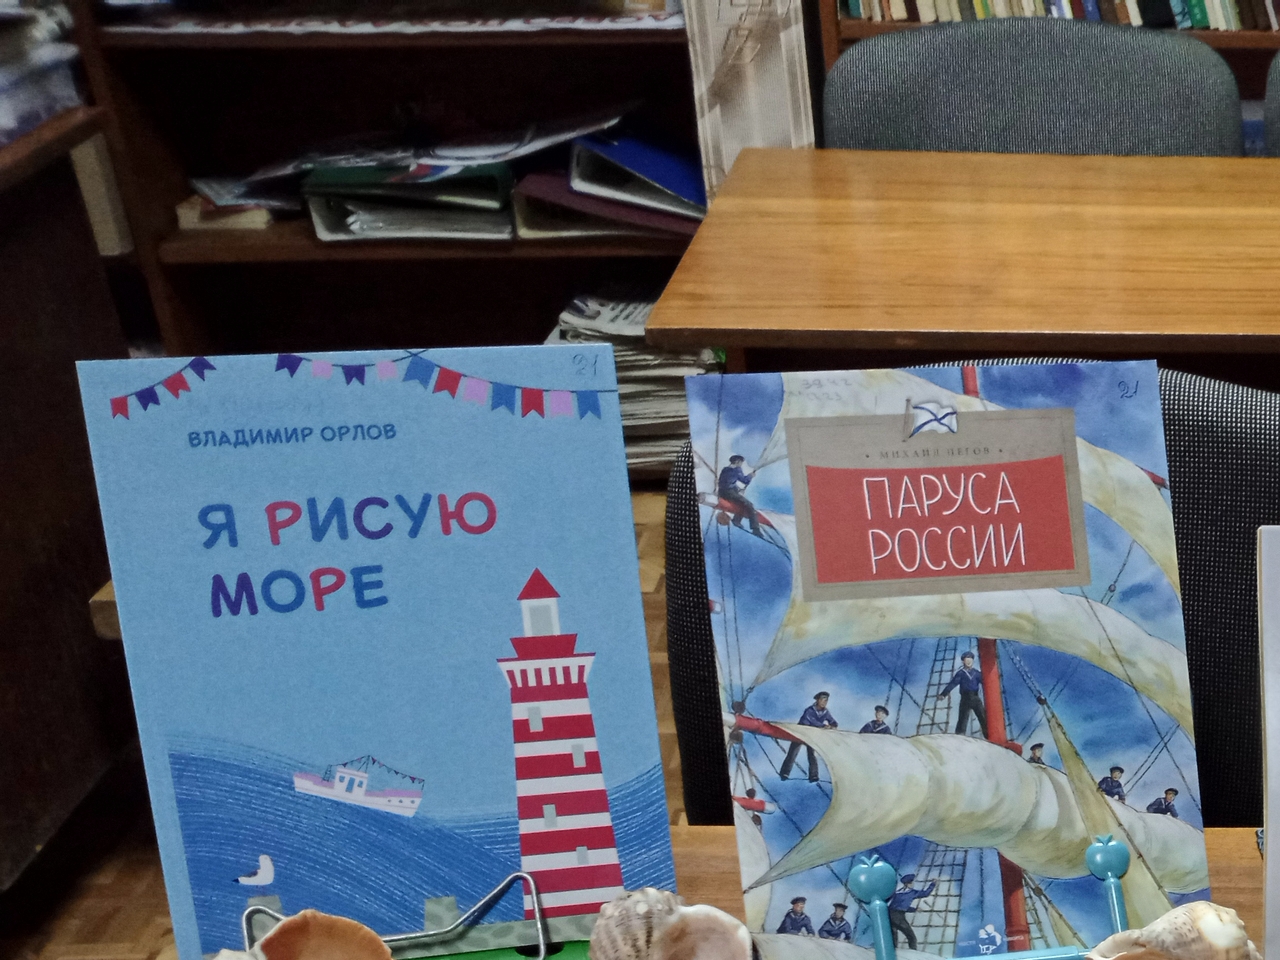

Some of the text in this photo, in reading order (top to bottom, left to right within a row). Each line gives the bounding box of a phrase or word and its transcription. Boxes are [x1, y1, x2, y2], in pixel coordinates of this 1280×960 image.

[187, 423, 397, 449] ВЛАДИМИР ОРЛОВ
[197, 491, 498, 549] Я РИСУЮ
[862, 470, 1021, 520] ПАРУСА
[868, 521, 1026, 575] РОССИИ
[210, 564, 389, 618] МОРЕ
